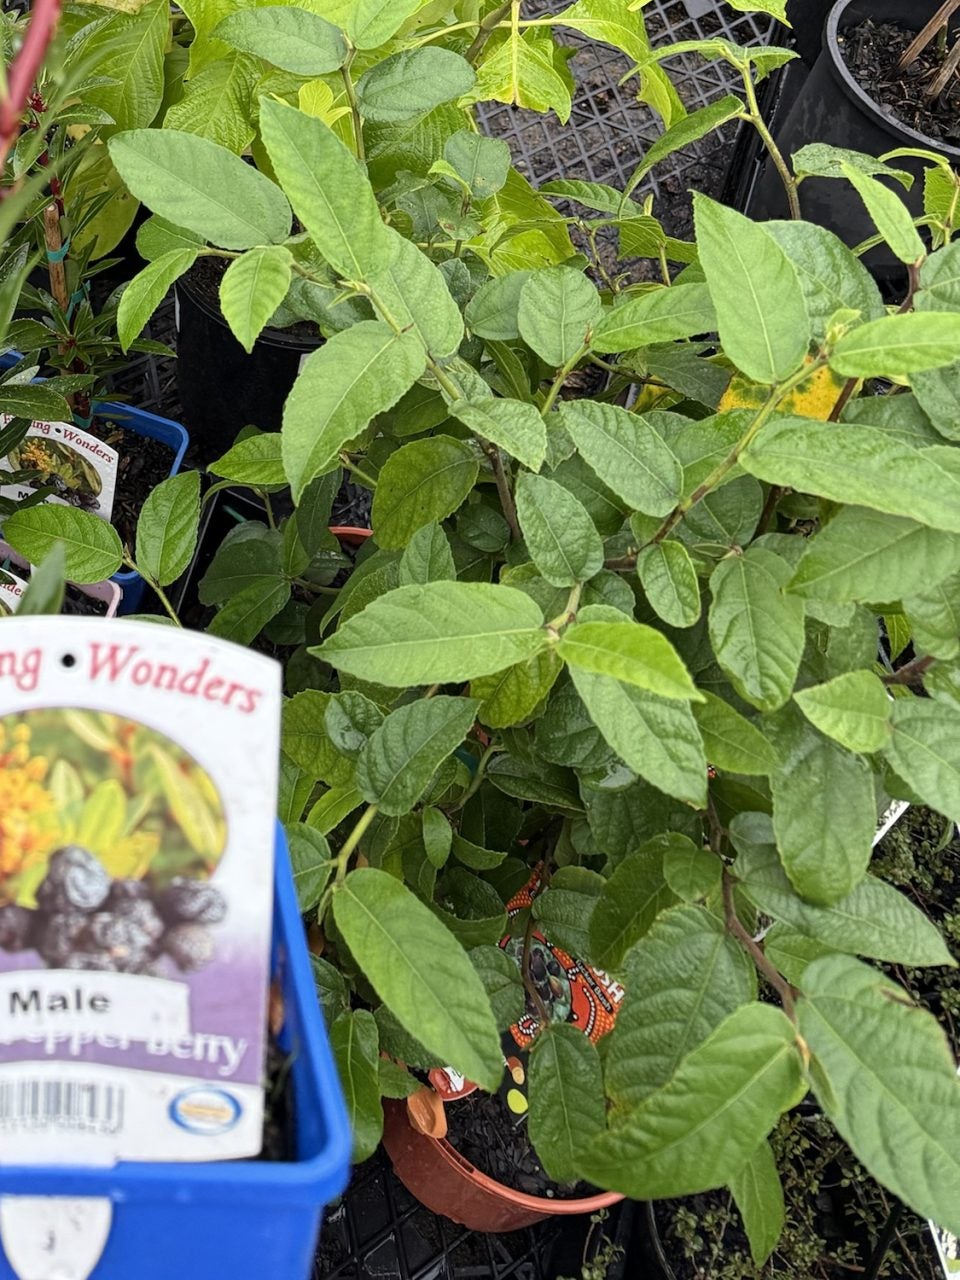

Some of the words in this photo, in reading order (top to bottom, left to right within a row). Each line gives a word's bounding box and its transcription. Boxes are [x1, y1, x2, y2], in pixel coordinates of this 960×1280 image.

[62, 428, 114, 464] Wonders
[88, 642, 263, 715] Wonders
[9, 988, 112, 1014] Male
[594, 986, 611, 1011] Bush
